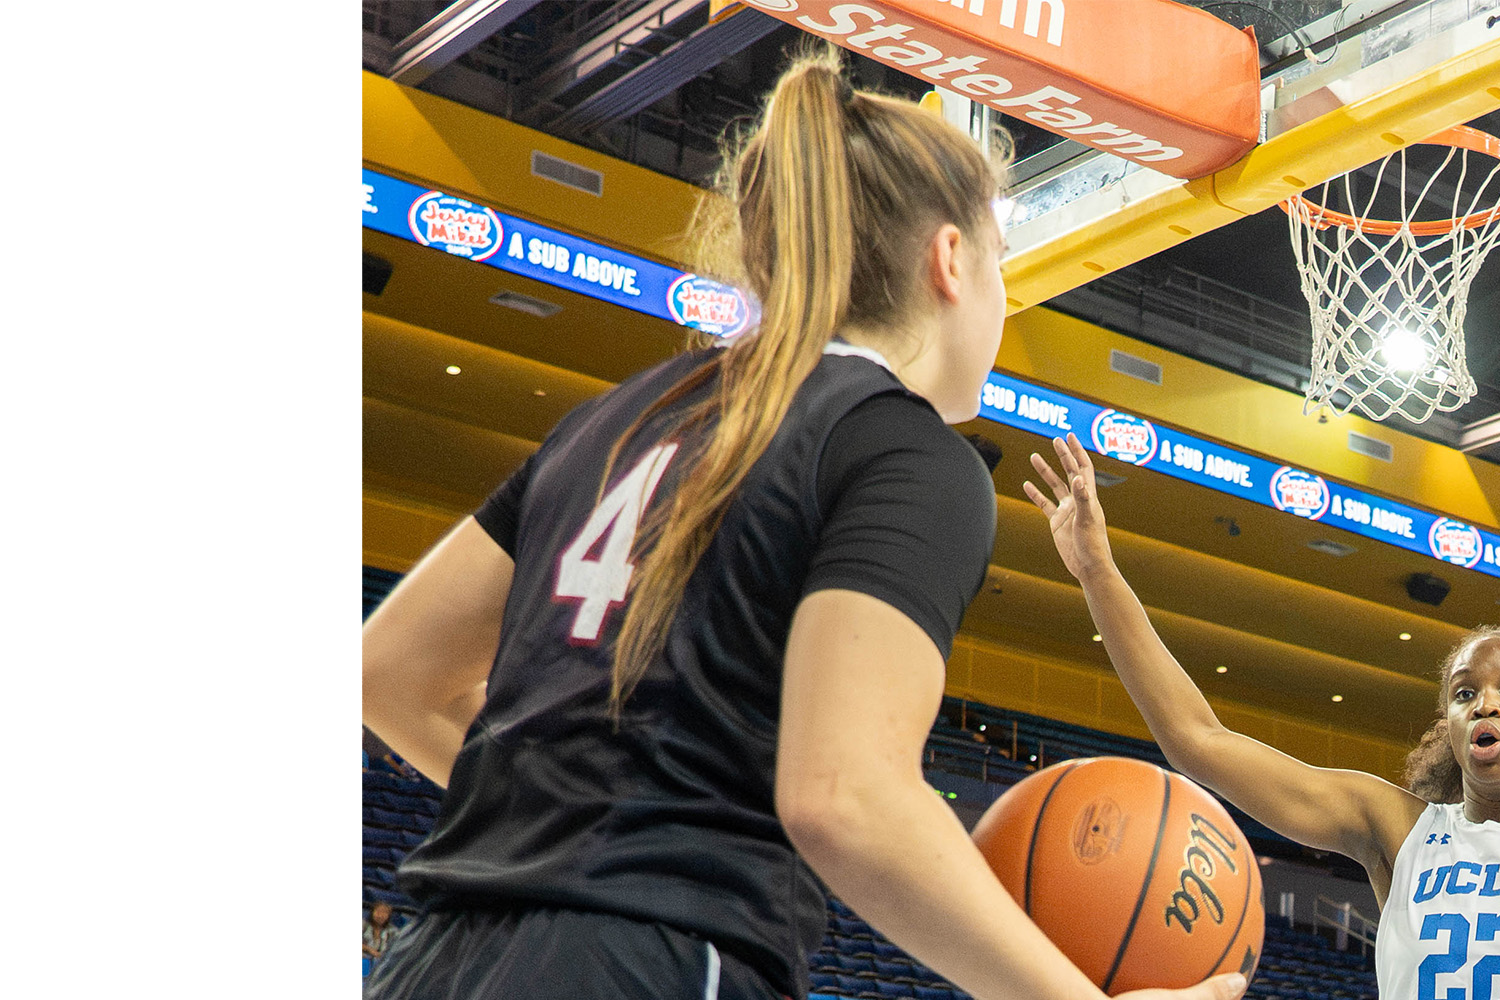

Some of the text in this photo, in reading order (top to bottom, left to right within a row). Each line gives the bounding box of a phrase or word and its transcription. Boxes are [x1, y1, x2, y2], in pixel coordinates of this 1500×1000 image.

[796, 3, 1014, 99] State
[987, 85, 1184, 163] Farm
[423, 202, 488, 232] Jersey
[508, 232, 641, 296] A SUB ABOVE.
[982, 383, 1071, 430] SUB ABOVE.
[1160, 440, 1253, 488] A SUB ABOVE.
[1331, 495, 1416, 539] A SUB ABOVE.
[553, 441, 681, 644] 4
[1483, 543, 1494, 564] A
[1163, 812, 1238, 934] Ucla
